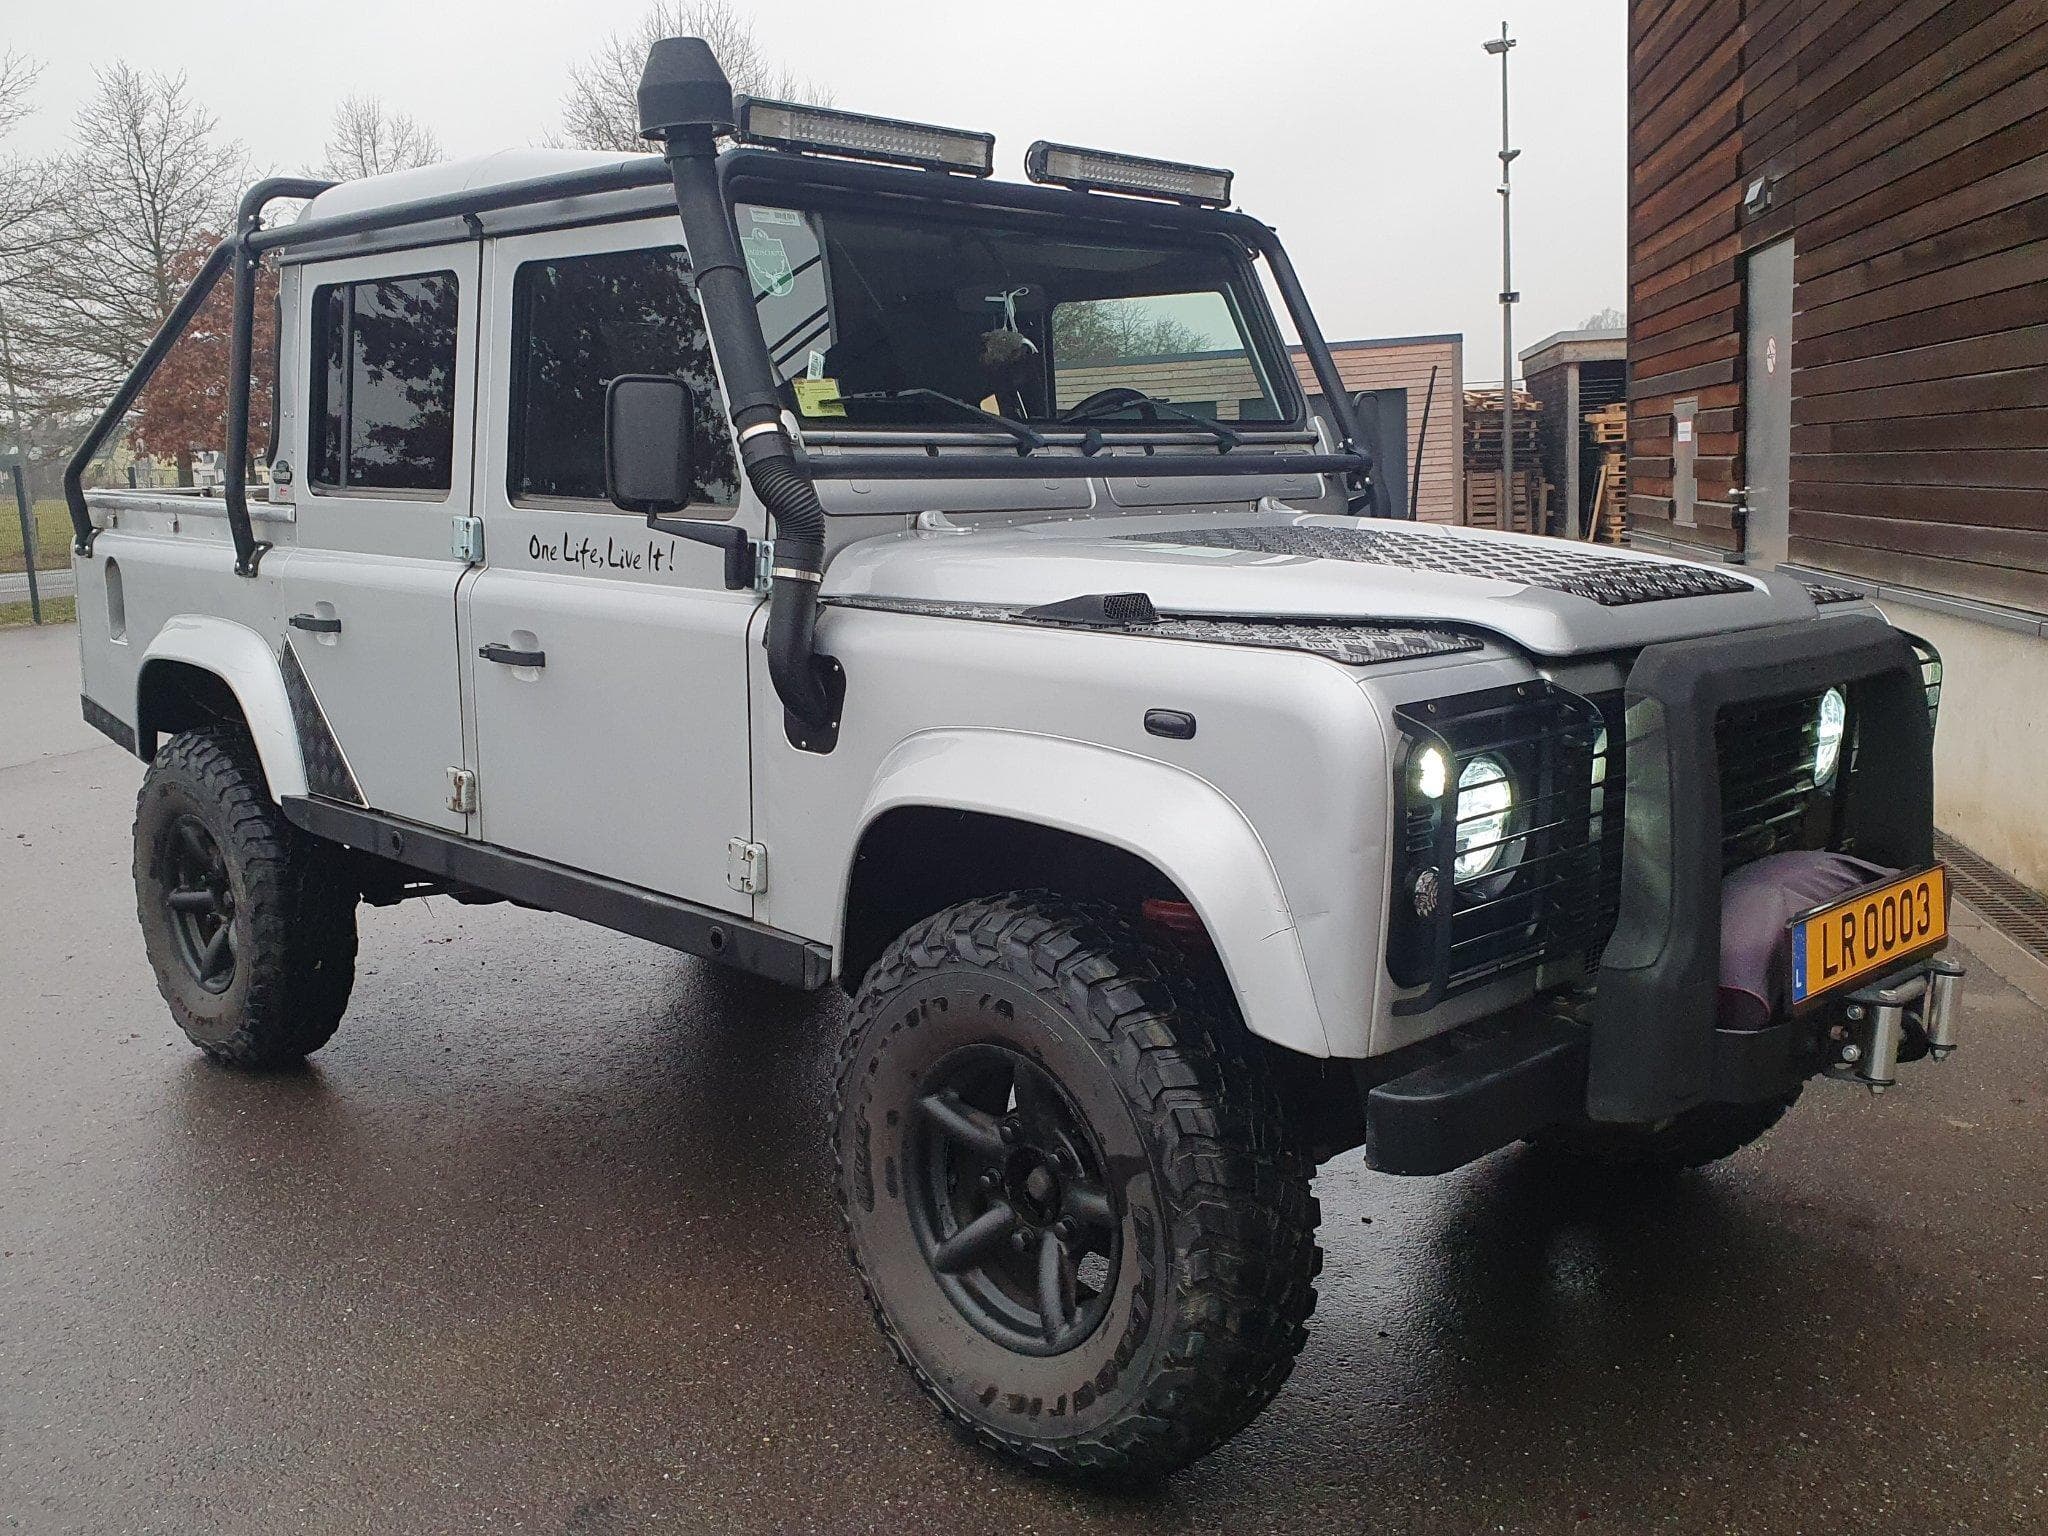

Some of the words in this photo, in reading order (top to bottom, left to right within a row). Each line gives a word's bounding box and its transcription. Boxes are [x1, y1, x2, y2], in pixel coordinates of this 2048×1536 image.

[529, 534, 557, 562] One
[563, 531, 603, 570] Life,
[608, 536, 641, 570] Live
[1822, 883, 1930, 979] LR0003
[1795, 968, 1802, 989] L
